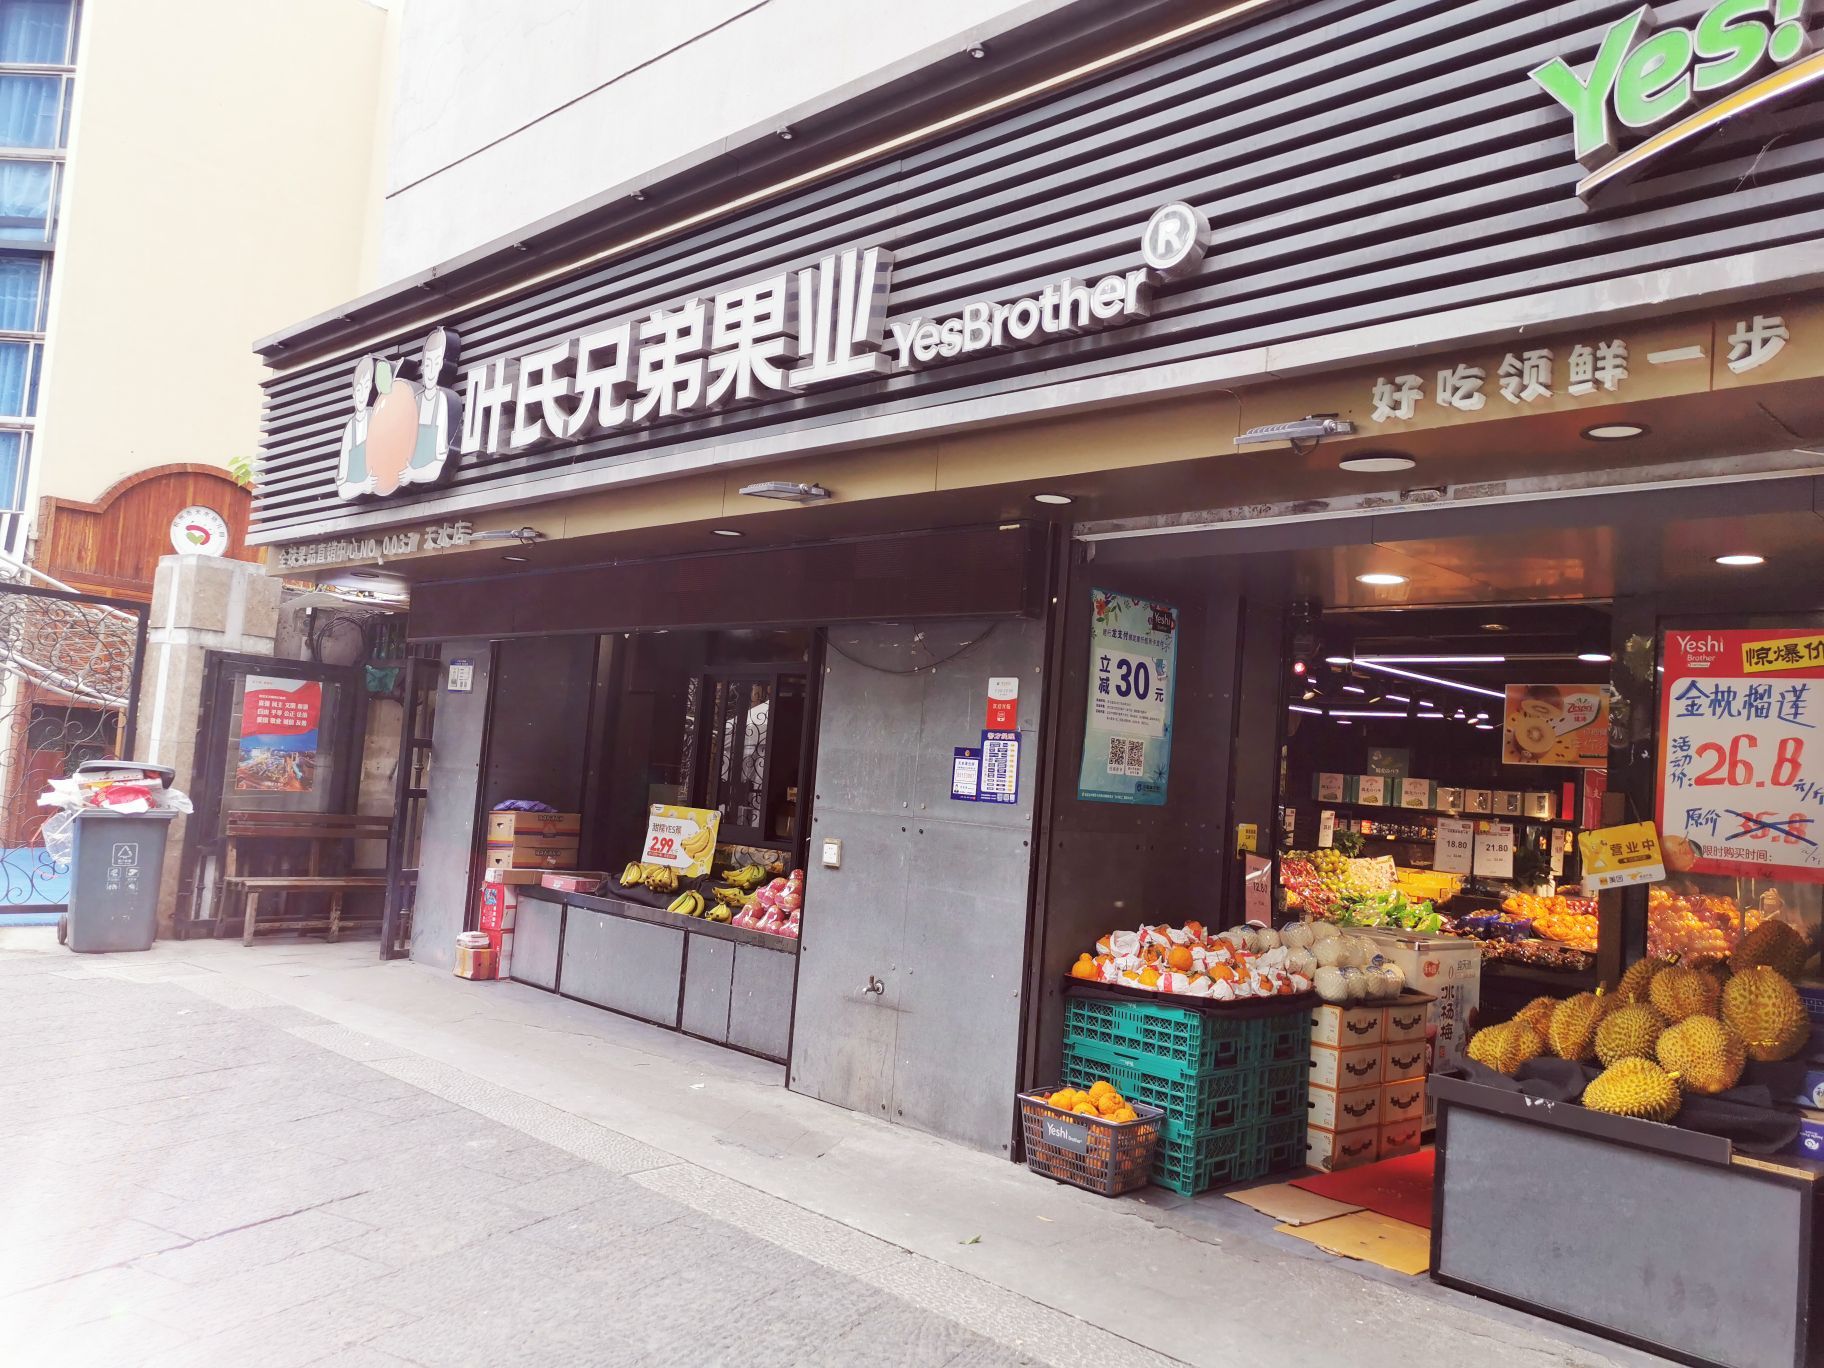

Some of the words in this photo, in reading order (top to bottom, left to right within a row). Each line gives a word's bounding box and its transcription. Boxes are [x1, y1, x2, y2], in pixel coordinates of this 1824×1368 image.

[890, 267, 1154, 369] YesBrother
[460, 246, 886, 455] 叶氏兄弟果业
[1371, 315, 1790, 423] 好吃领鲜一步
[1154, 612, 1171, 625] Yeshi
[1676, 635, 1724, 653] Yeshi
[1687, 653, 1716, 662] Brother
[1098, 654, 1111, 695] 立减
[1116, 658, 1150, 700] 30
[1155, 687, 1164, 702] 元
[1674, 679, 1816, 728] 金枕榴莲
[1694, 734, 1805, 788] 26.8
[1685, 808, 1721, 837] 原价
[650, 836, 674, 853] 2.99
[1447, 840, 1468, 849] 18.80
[1486, 844, 1508, 852] 21.80
[1610, 838, 1655, 857] 营业中
[1609, 875, 1624, 884] 美团
[1440, 985, 1455, 1041] 冰杨梅
[1047, 1121, 1068, 1139] Yeshi
